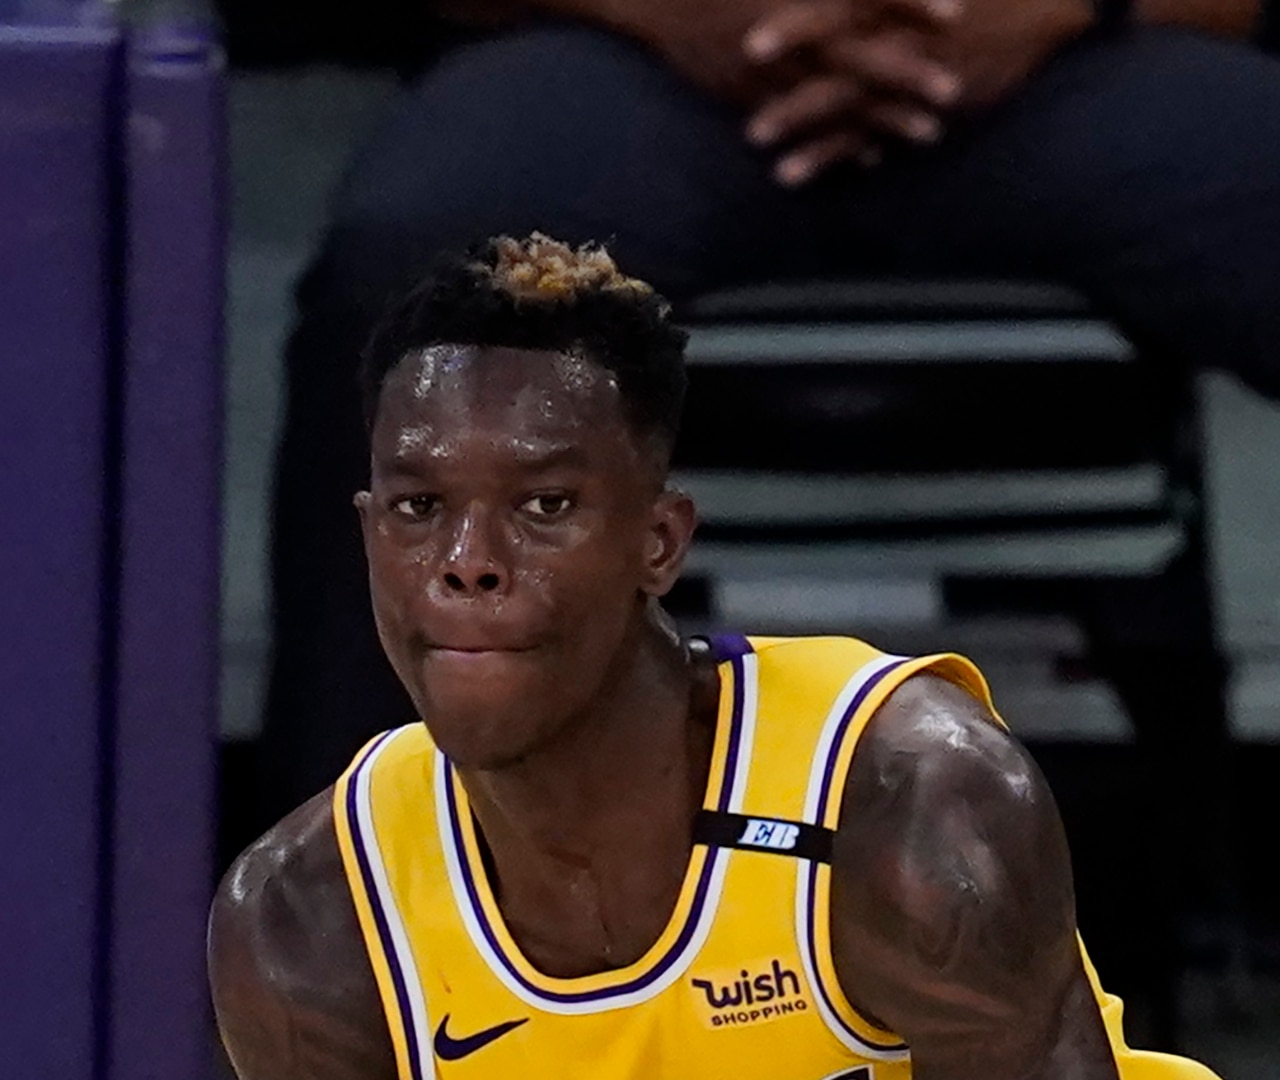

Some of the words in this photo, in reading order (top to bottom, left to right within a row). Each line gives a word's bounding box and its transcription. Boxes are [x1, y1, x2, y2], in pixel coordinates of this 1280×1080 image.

[737, 819, 800, 850] EB
[691, 959, 800, 1009] wish
[711, 999, 808, 1027] SHOPPING
